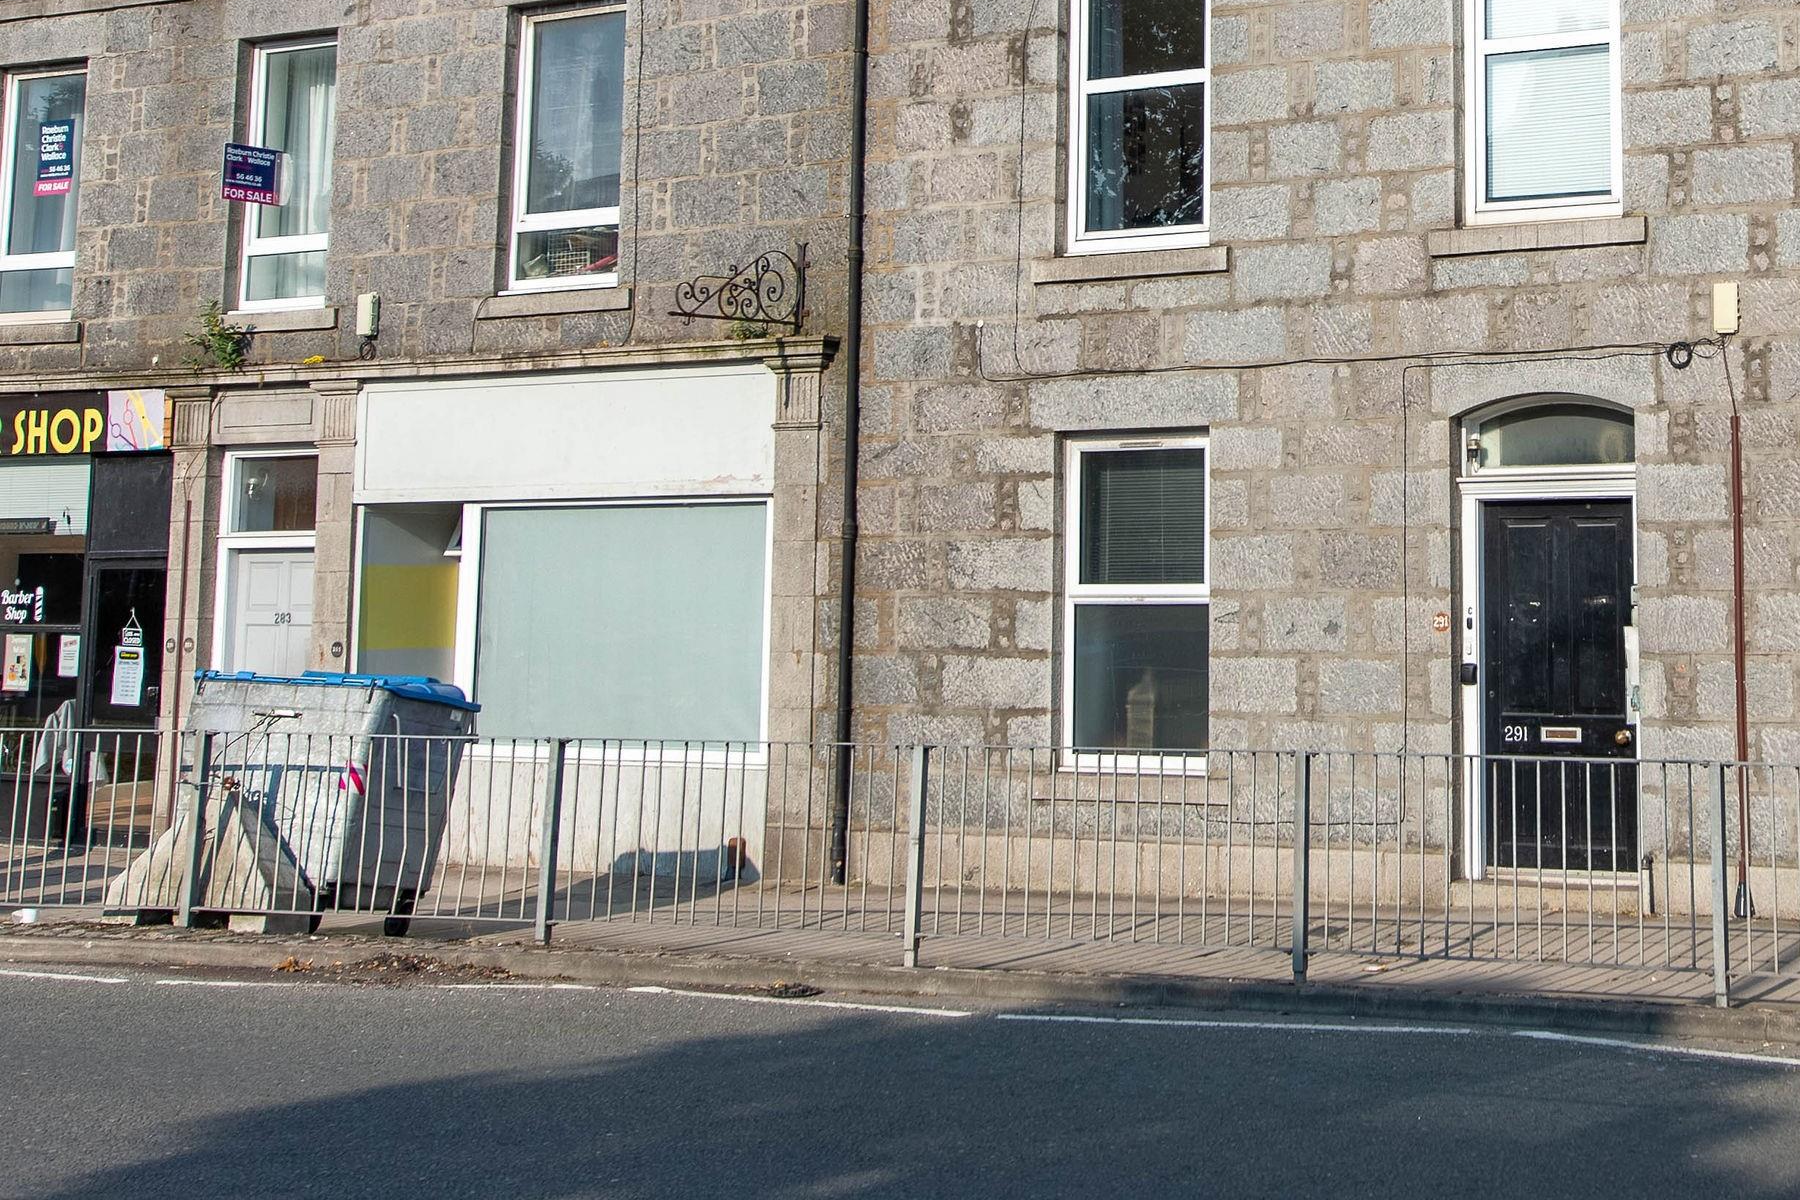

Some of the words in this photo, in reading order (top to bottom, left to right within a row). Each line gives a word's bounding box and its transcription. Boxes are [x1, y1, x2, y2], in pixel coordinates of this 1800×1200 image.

[41, 133, 66, 143] Christie
[41, 143, 59, 152] Clark
[41, 152, 66, 161] Wallace
[226, 154, 243, 162] Clark
[247, 157, 271, 166] Wallace
[252, 151, 275, 160] Christie
[38, 183, 52, 191] FOR
[53, 181, 69, 191] SALE
[223, 187, 245, 199] FOR
[246, 190, 273, 203] SALE
[11, 408, 104, 455] SHOP
[1, 589, 34, 605] Barber
[4, 606, 27, 624] Shop
[274, 612, 292, 624] 283
[1433, 615, 1449, 628] 291
[1504, 725, 1528, 742] 291
